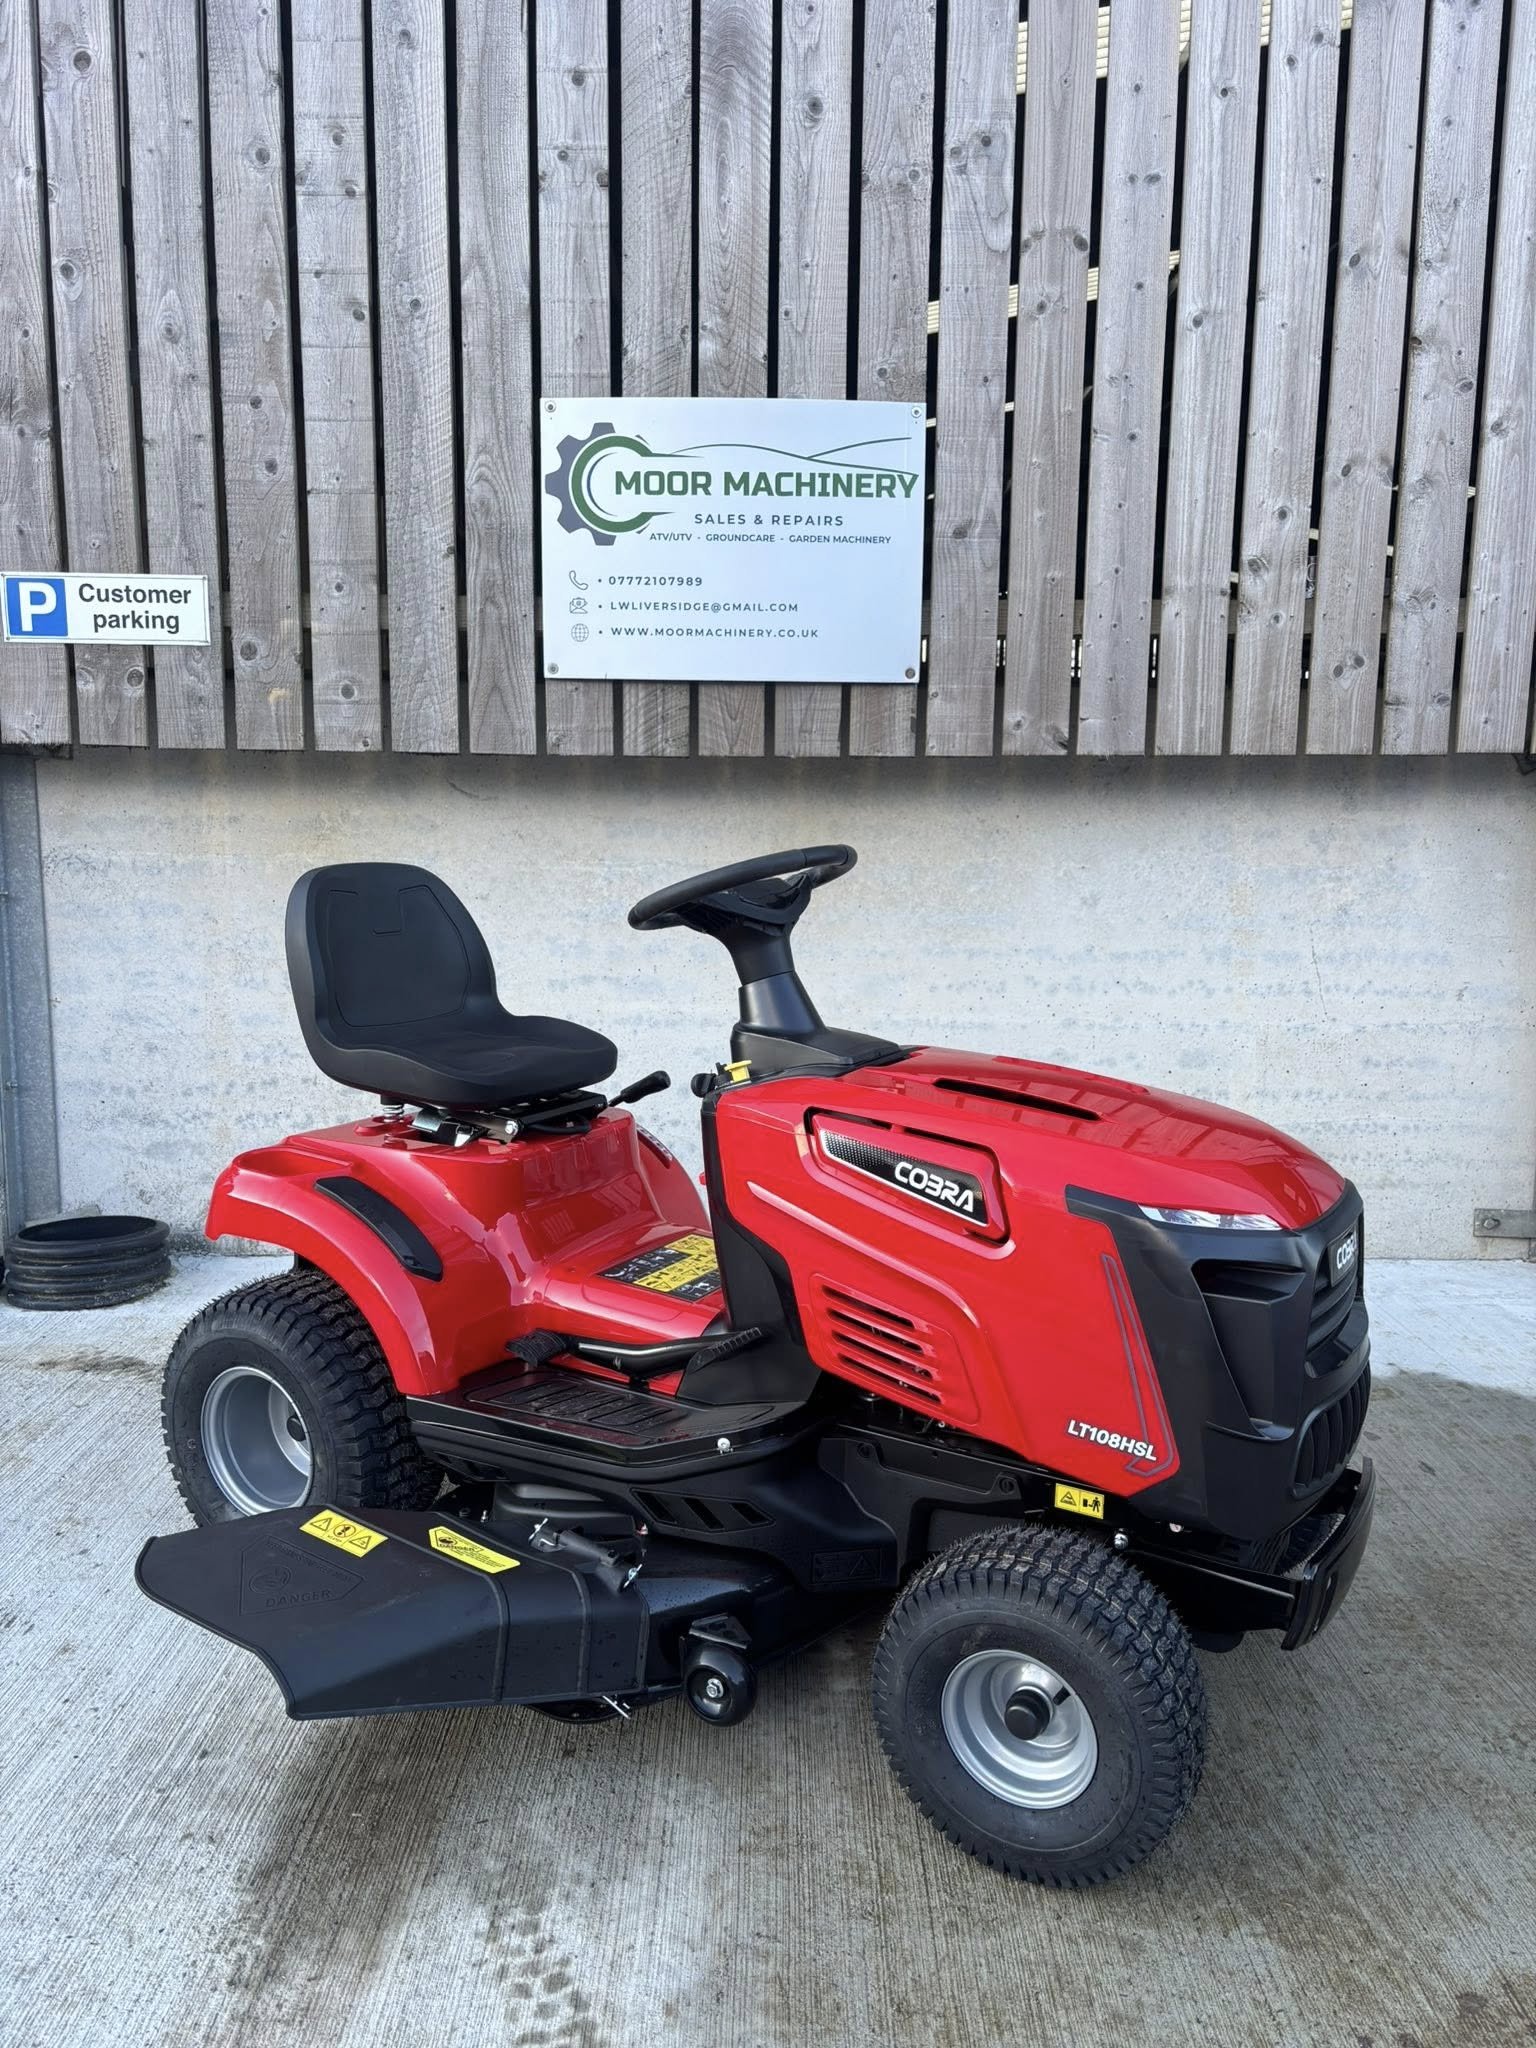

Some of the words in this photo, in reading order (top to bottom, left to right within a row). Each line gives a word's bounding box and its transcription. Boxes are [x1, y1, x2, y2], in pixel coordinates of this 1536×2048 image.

[615, 470, 712, 496] MOOR
[723, 472, 919, 499] MACHINERY
[694, 513, 747, 526] SALES
[753, 514, 764, 526] &
[771, 514, 844, 527] REPAIRS
[649, 532, 693, 542] ATV/UTV
[705, 533, 776, 543] GROUNDCARE
[788, 534, 831, 544] GARDEN
[832, 535, 892, 545] MACHINERY
[608, 575, 703, 587] 07772107989
[78, 583, 192, 604] Customer
[18, 581, 57, 632] P
[610, 601, 799, 614] LWLIVERSIDGE@GMAIL.COM
[93, 610, 180, 634] parking
[610, 626, 820, 639] WWW.MOORMACHINERY.CO.UK
[894, 1160, 974, 1213] COBRA
[1067, 1419, 1157, 1461] LT108HSL
[265, 1589, 331, 1608] DANGER
